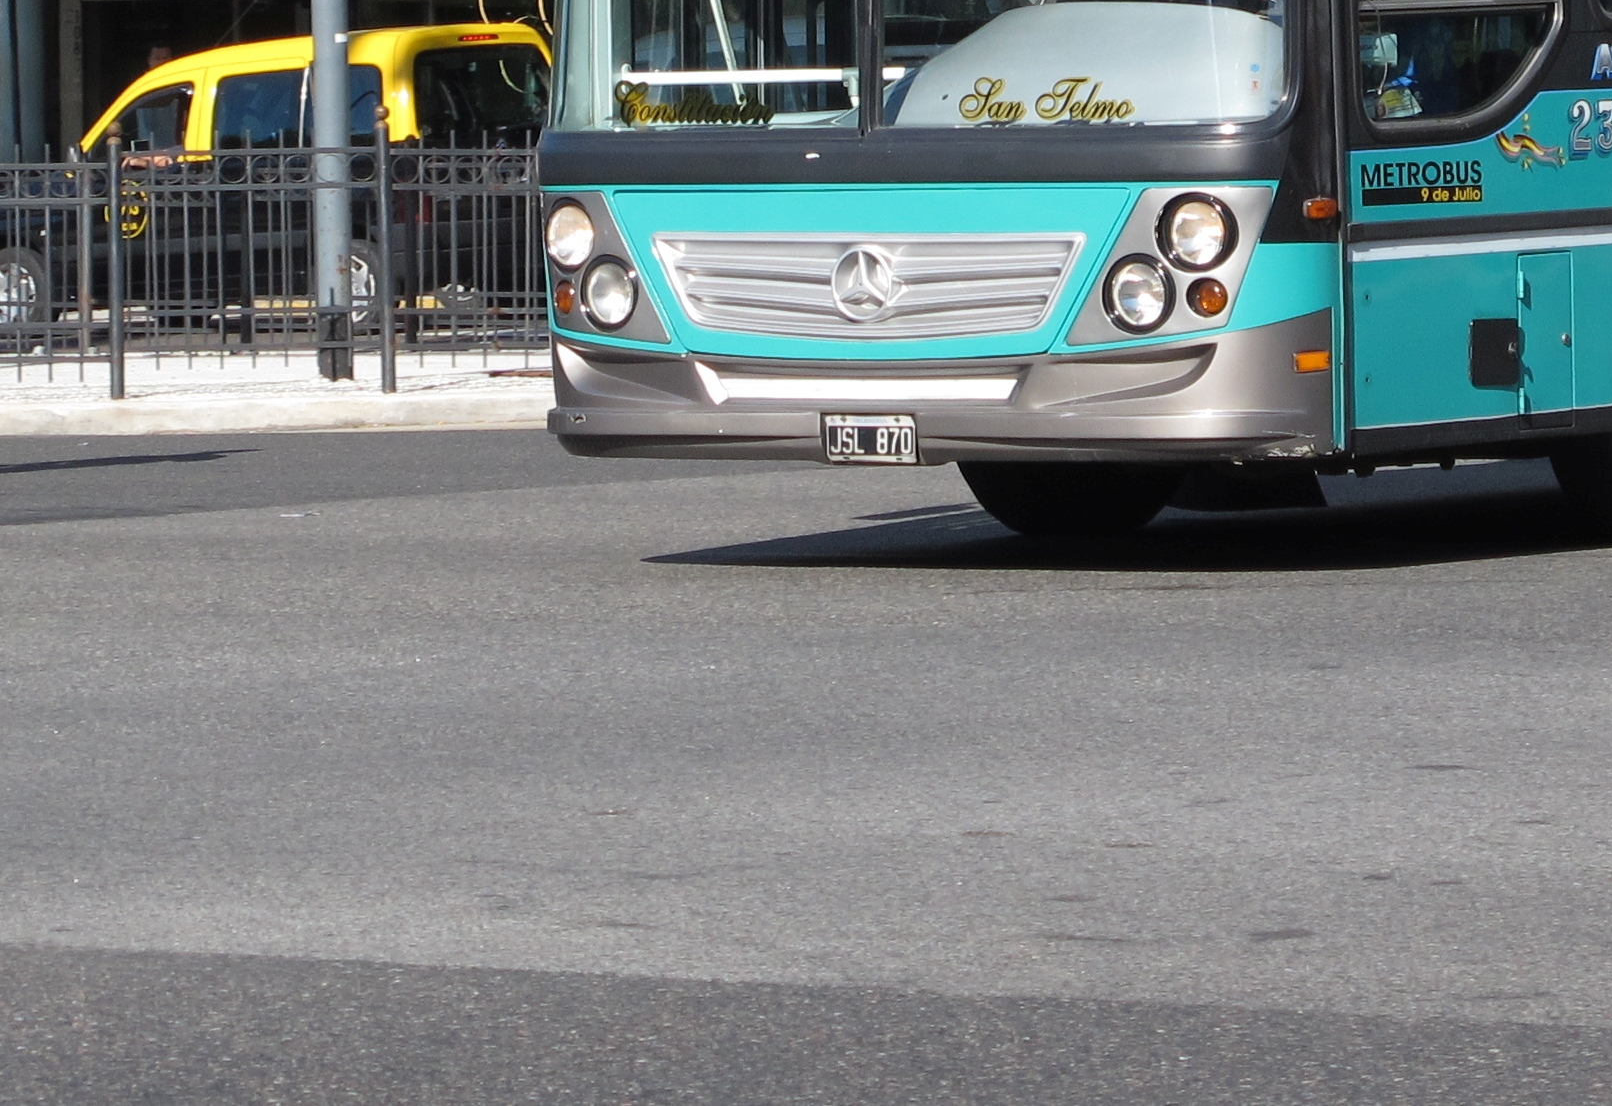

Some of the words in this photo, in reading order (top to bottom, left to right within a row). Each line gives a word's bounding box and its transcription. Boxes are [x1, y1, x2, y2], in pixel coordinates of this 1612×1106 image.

[959, 77, 1025, 122] San
[1035, 78, 1134, 122] Telmo
[1360, 160, 1483, 188] METROBUS
[1421, 188, 1429, 202] 9
[1432, 187, 1450, 201] de
[1452, 186, 1481, 201] Julio
[830, 427, 865, 454] JSL
[876, 427, 912, 454] 870
